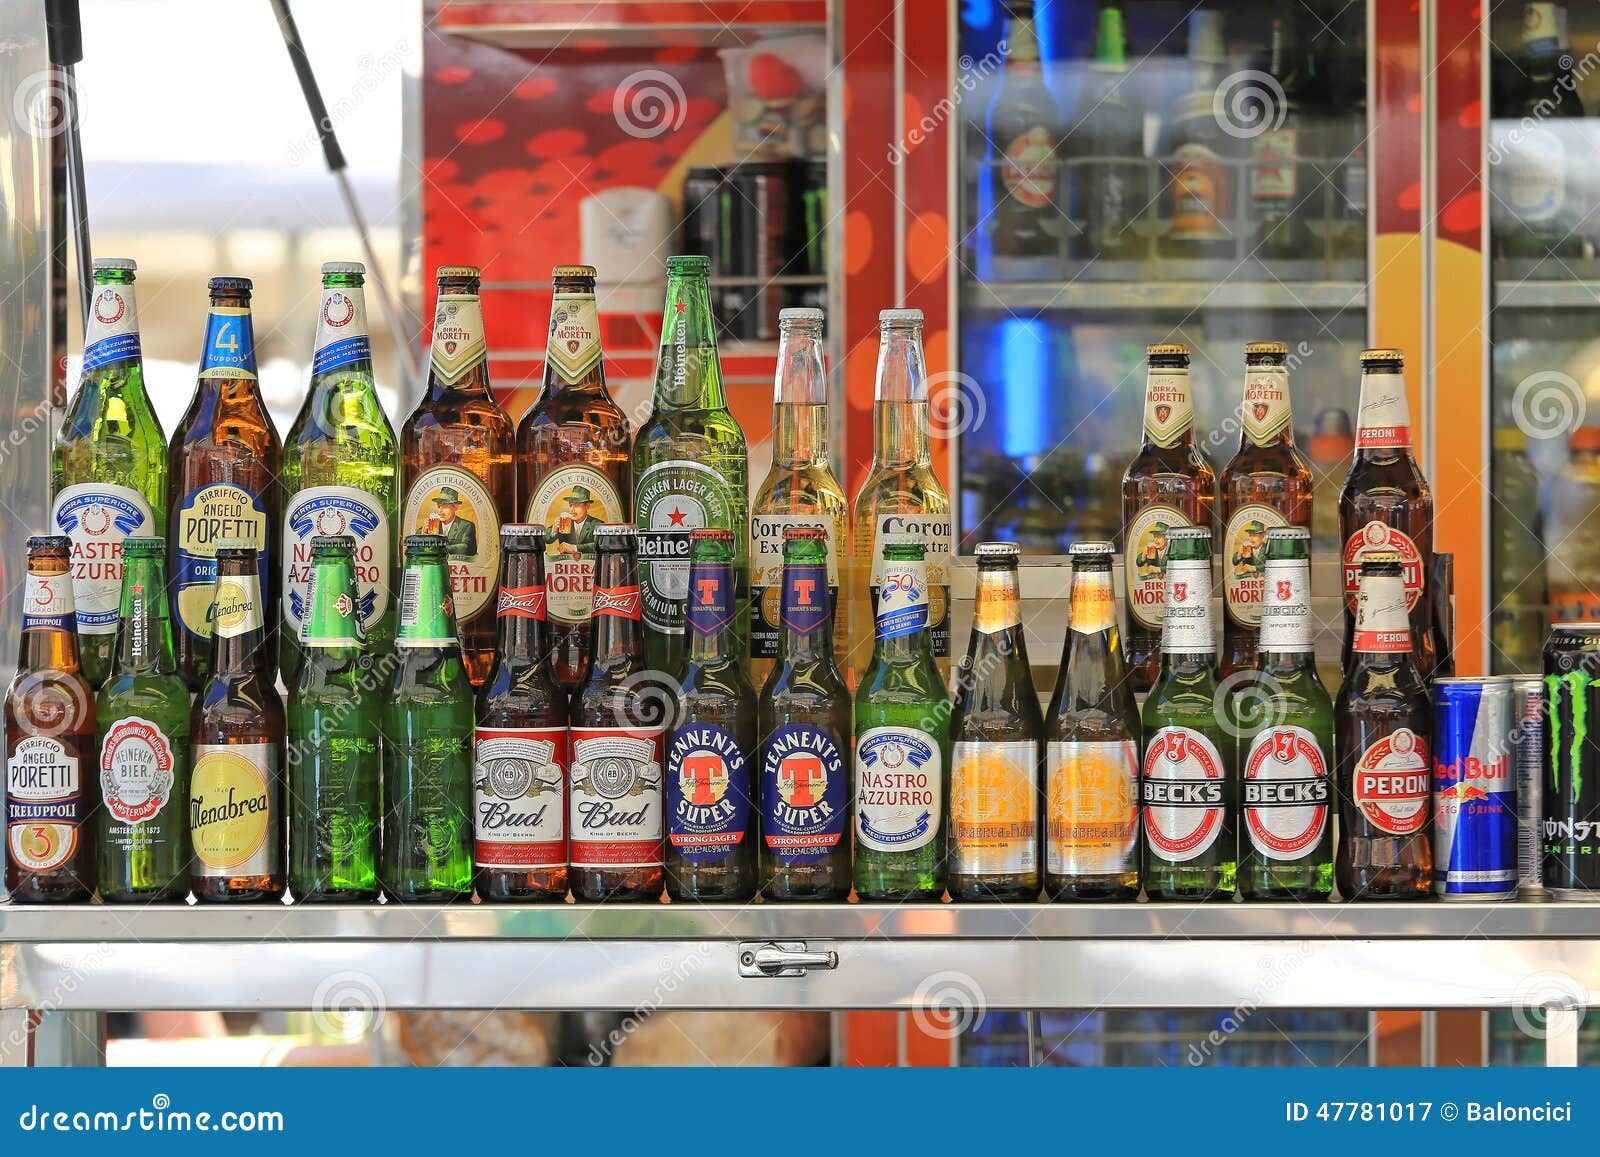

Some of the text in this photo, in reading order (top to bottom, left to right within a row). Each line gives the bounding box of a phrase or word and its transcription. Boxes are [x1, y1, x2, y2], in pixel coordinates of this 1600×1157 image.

[215, 322, 239, 353] 4
[437, 332, 470, 341] MORETTI
[557, 331, 592, 340] MORETTI
[208, 353, 248, 363] LUPPOLI
[674, 319, 686, 387] Heineken
[211, 370, 241, 378] ORIGINALE
[1147, 391, 1185, 403] MORETTI
[1152, 385, 1177, 393] BIRRA
[1245, 389, 1283, 401] MORETTI
[1361, 428, 1396, 438] PERONI
[199, 489, 248, 505] BIRRIFICIO
[444, 476, 483, 506] TRADIZIONE
[576, 475, 613, 505] TRADIZIONE
[640, 478, 724, 519] HEINEKEN LAGER BEER
[59, 495, 142, 517] BIRRA SUPERIORE
[203, 503, 242, 518] ANGELO
[292, 499, 374, 521] BIRRA SUPERIORE
[186, 518, 258, 544] PORETTI
[72, 542, 123, 560] ASTR
[637, 535, 689, 556] Heine
[919, 541, 951, 554] xtra
[35, 580, 54, 605] 3
[450, 576, 488, 593] ETTI
[697, 579, 719, 605] T
[793, 579, 816, 605] T
[887, 573, 914, 592] 50
[500, 591, 537, 609] Bud
[594, 593, 632, 609] Bud
[640, 580, 678, 616] PREMIUM
[131, 598, 142, 657] Heineken
[20, 740, 61, 753] BIRRIFICIO
[668, 729, 744, 773] TENNENT'S
[764, 731, 842, 774] TENNENT'S
[861, 735, 928, 752] BIRRA SUPERIORE
[22, 752, 55, 765] ANGELO
[115, 747, 154, 764] HEINEKEN
[12, 765, 71, 788] PORETTI
[1464, 754, 1510, 780] Bull
[682, 755, 723, 806] T
[781, 757, 822, 808] T
[862, 771, 927, 788] NASTRO
[858, 788, 933, 806] AZZURRO
[1143, 781, 1222, 803] BECK'S
[1244, 779, 1328, 803] BECK'S
[9, 803, 76, 818] TRELUPPOLI
[113, 801, 155, 818] AMSTERDAM
[190, 787, 268, 832] Menabrea
[478, 801, 548, 830] Bud
[577, 801, 651, 829] Bud
[676, 798, 737, 824] SUPER
[773, 800, 834, 826] SUPER
[1468, 804, 1503, 816] DRINK
[109, 826, 161, 835] AMSTERDAM 1873
[709, 834, 737, 842] LAGER
[865, 827, 922, 843] MEDITERRANEA
[1256, 823, 1319, 849] BREMEN GERMANY
[28, 827, 53, 858] 3
[772, 837, 806, 845] STRONG
